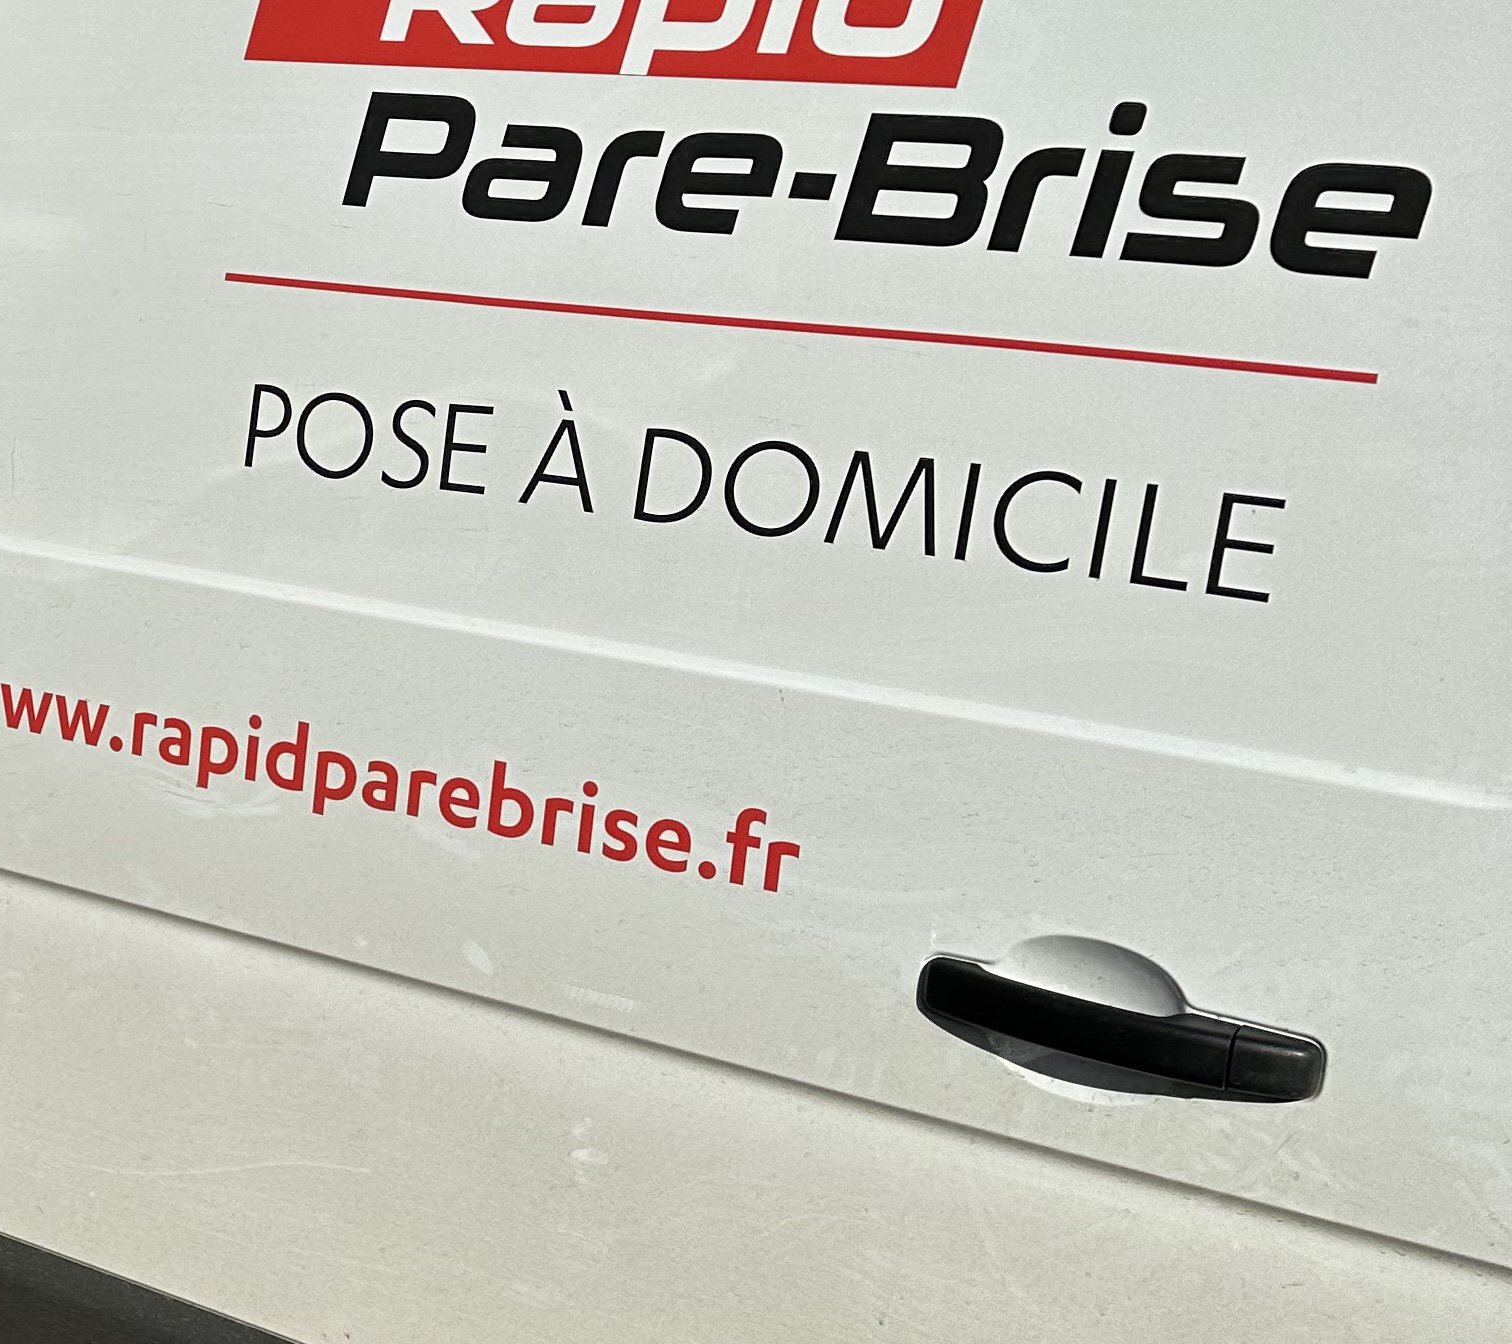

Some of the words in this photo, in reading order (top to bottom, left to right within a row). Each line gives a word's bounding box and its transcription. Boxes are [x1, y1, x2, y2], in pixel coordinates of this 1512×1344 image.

[342, 90, 1433, 280] Pare-Brise
[244, 383, 494, 495] POSE
[519, 389, 595, 514] À
[634, 426, 1286, 604] DOMICILE
